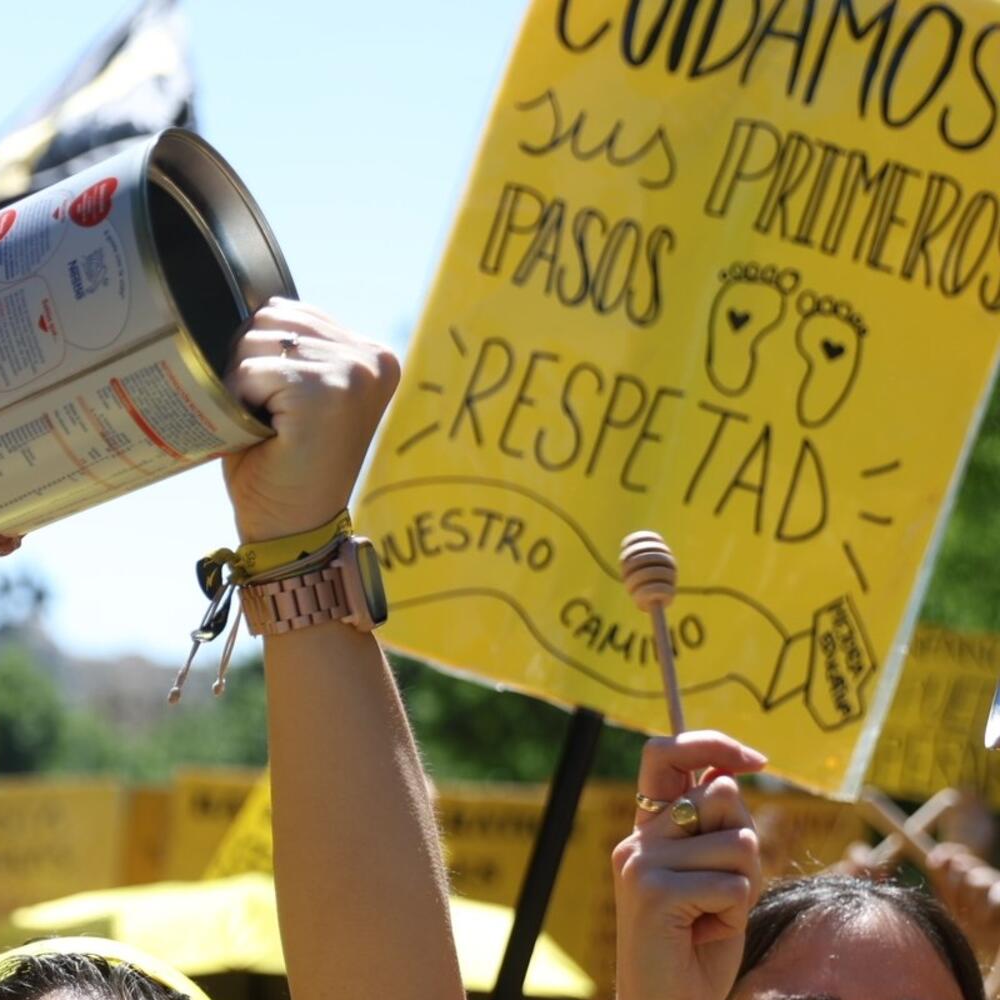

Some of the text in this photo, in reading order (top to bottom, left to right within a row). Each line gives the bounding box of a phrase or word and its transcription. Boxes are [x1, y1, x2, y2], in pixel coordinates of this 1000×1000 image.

[479, 181, 676, 327] PASOS
[448, 336, 829, 543] RESPETAD
[376, 508, 554, 571] NUESTRO
